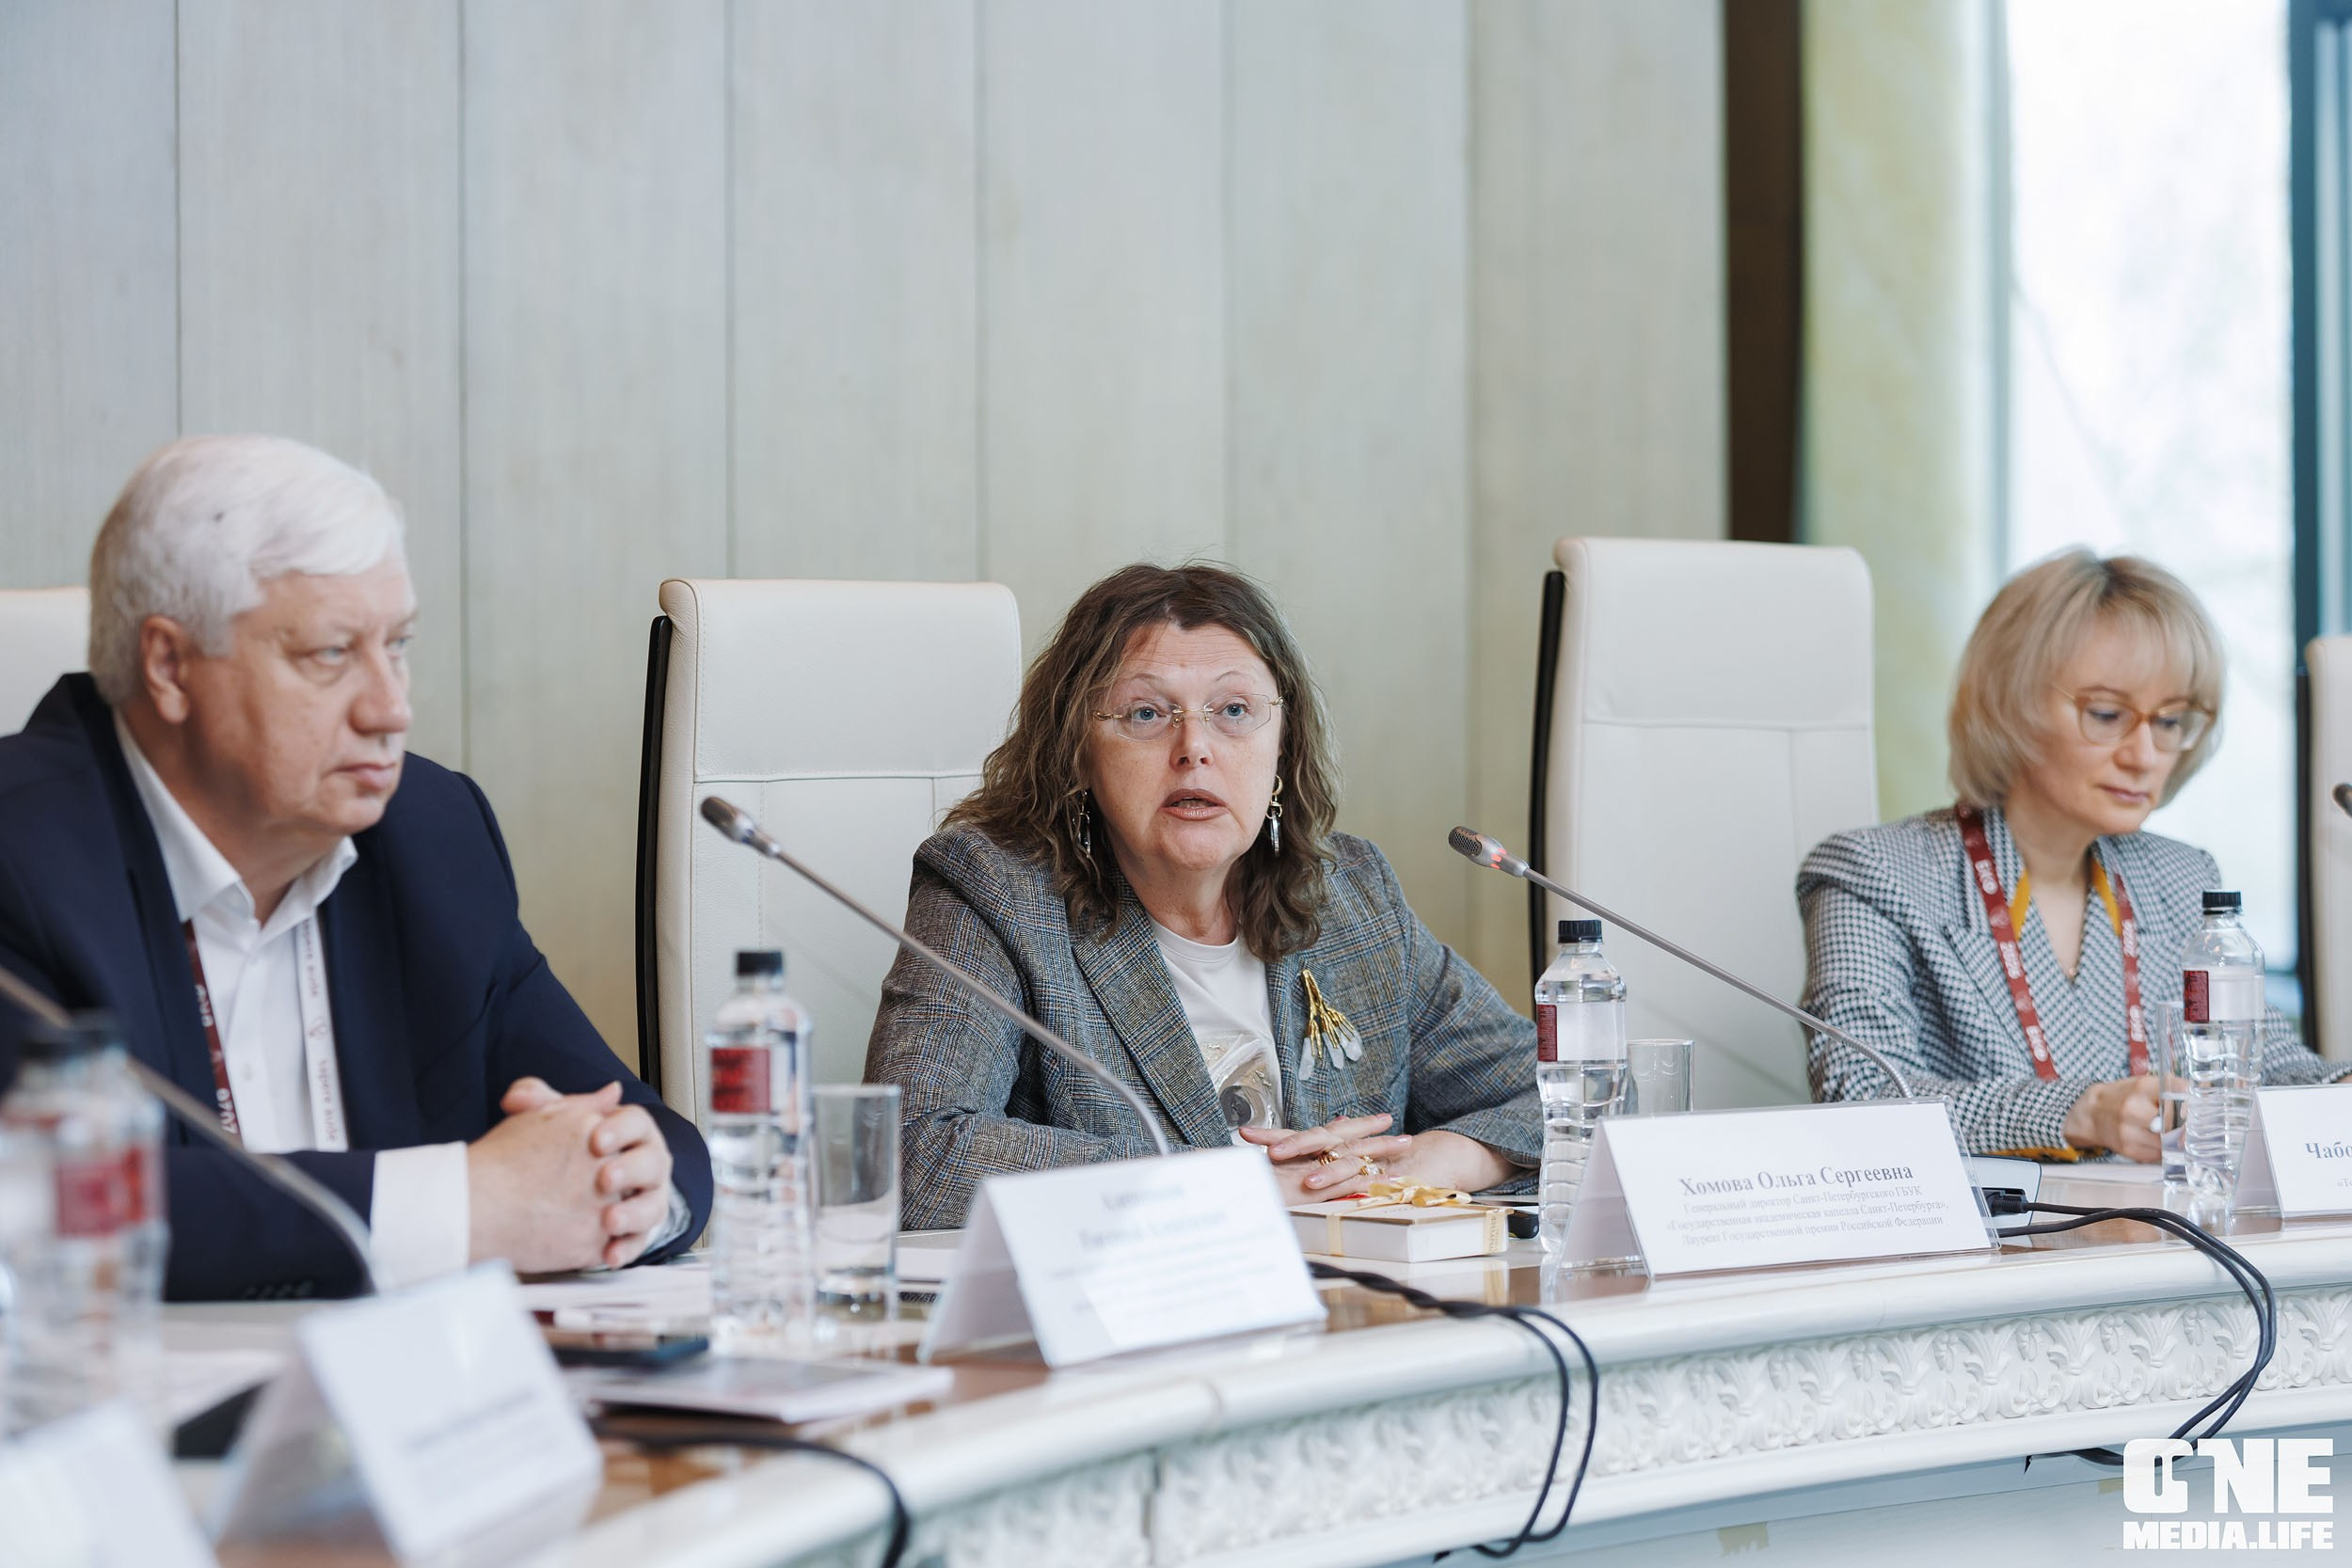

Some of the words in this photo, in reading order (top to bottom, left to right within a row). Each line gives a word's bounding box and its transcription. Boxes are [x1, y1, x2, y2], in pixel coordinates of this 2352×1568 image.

[1679, 1178, 1754, 1196] Хомова
[1757, 1171, 1816, 1189] Ольга
[1820, 1165, 1914, 1187] Сергеевна
[1683, 1199, 1747, 1214] Генеральный
[1749, 1196, 1791, 1211] директор
[1792, 1189, 1894, 1207] Санкт-Петербургского
[1895, 1185, 1923, 1197] ГБУК
[1683, 1234, 1721, 1247] Лауреат
[1722, 1225, 1804, 1242] Государственной
[1805, 1224, 1839, 1236] премии
[1840, 1217, 1892, 1233] Российской
[1894, 1214, 1944, 1228] Федерации
[1754, 1211, 1821, 1224] академическая
[1824, 1207, 1859, 1218] капелла
